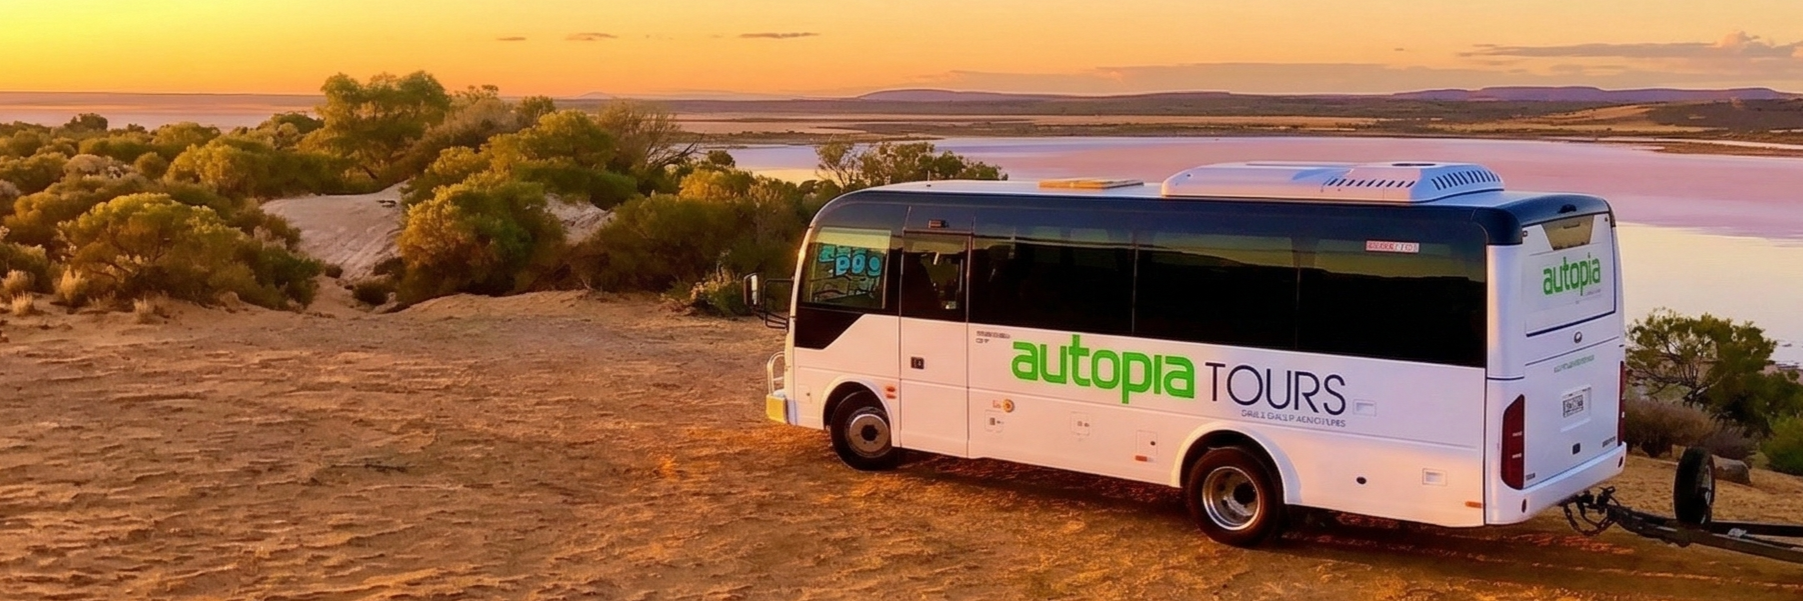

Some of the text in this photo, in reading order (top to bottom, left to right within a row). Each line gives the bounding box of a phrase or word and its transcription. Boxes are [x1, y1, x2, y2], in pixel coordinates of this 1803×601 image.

[1543, 252, 1601, 296] autopia
[1011, 334, 1346, 415] autopia TOURS
